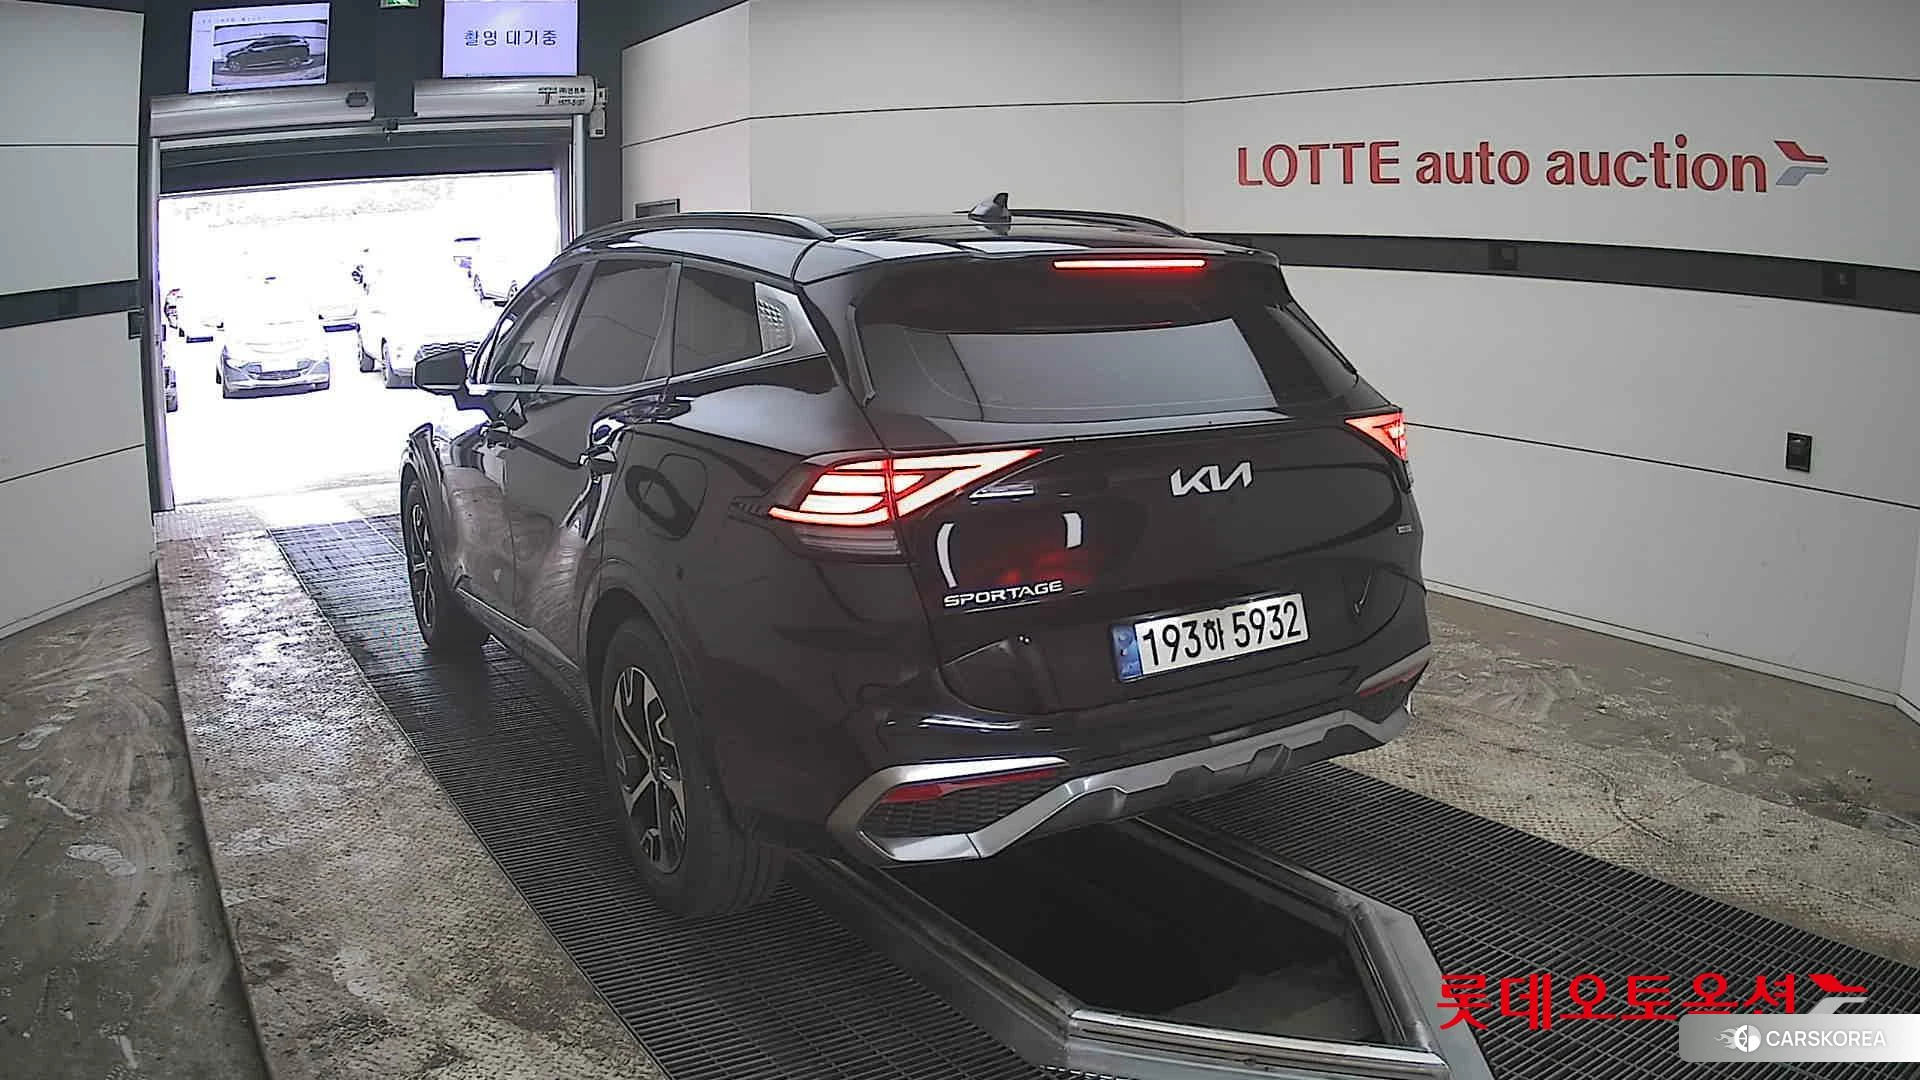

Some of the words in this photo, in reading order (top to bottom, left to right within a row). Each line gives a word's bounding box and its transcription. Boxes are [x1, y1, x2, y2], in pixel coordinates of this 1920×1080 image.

[464, 29, 498, 47] 촬영
[505, 29, 558, 47] 대기중
[1237, 140, 1401, 188] LOTTE
[1415, 141, 1530, 186] auto
[1545, 133, 1768, 193] auction
[1168, 461, 1254, 497] KIA
[943, 579, 1064, 608] SPORTAGE
